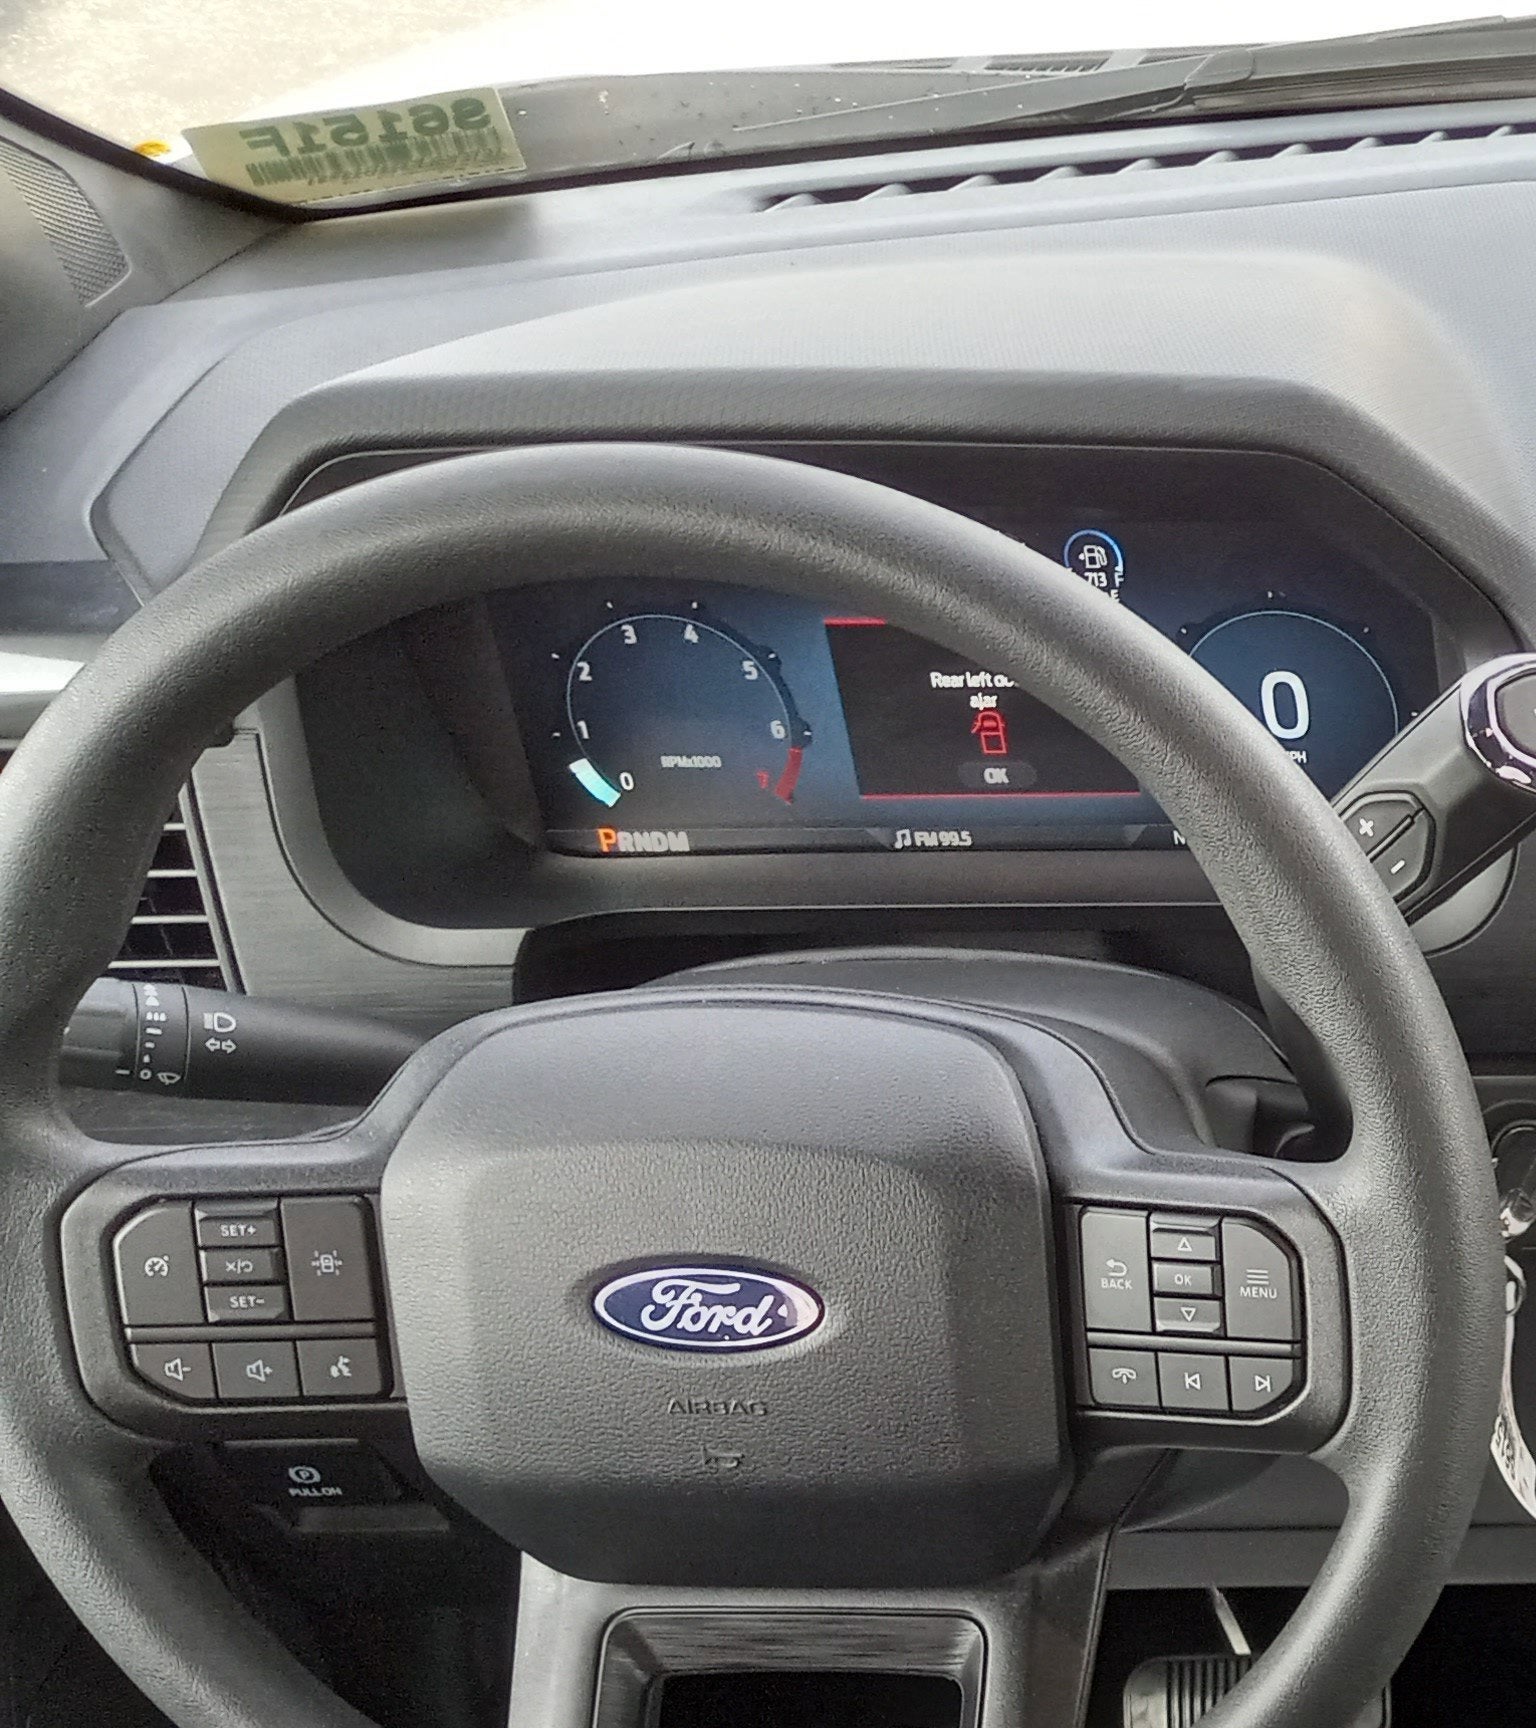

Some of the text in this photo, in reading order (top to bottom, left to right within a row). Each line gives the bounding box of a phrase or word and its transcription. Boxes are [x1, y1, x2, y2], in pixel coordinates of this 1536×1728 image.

[621, 625, 637, 645] 3
[683, 624, 699, 645] 4
[576, 660, 593, 682] 2
[741, 660, 759, 681] 5
[929, 672, 965, 688] Rear
[966, 671, 993, 688] left
[970, 693, 998, 710] ajar
[1261, 670, 1310, 740] 0
[577, 721, 589, 740] 1
[769, 720, 786, 740] 6
[619, 771, 635, 791] 0
[984, 768, 1009, 784] OK
[914, 831, 973, 847] FM 99.5
[1101, 1278, 1132, 1290] BACK
[1174, 1274, 1192, 1286] OK
[1239, 1287, 1278, 1299] MENU
[641, 1279, 774, 1336] Ford
[667, 1399, 768, 1416] AIRBAG
